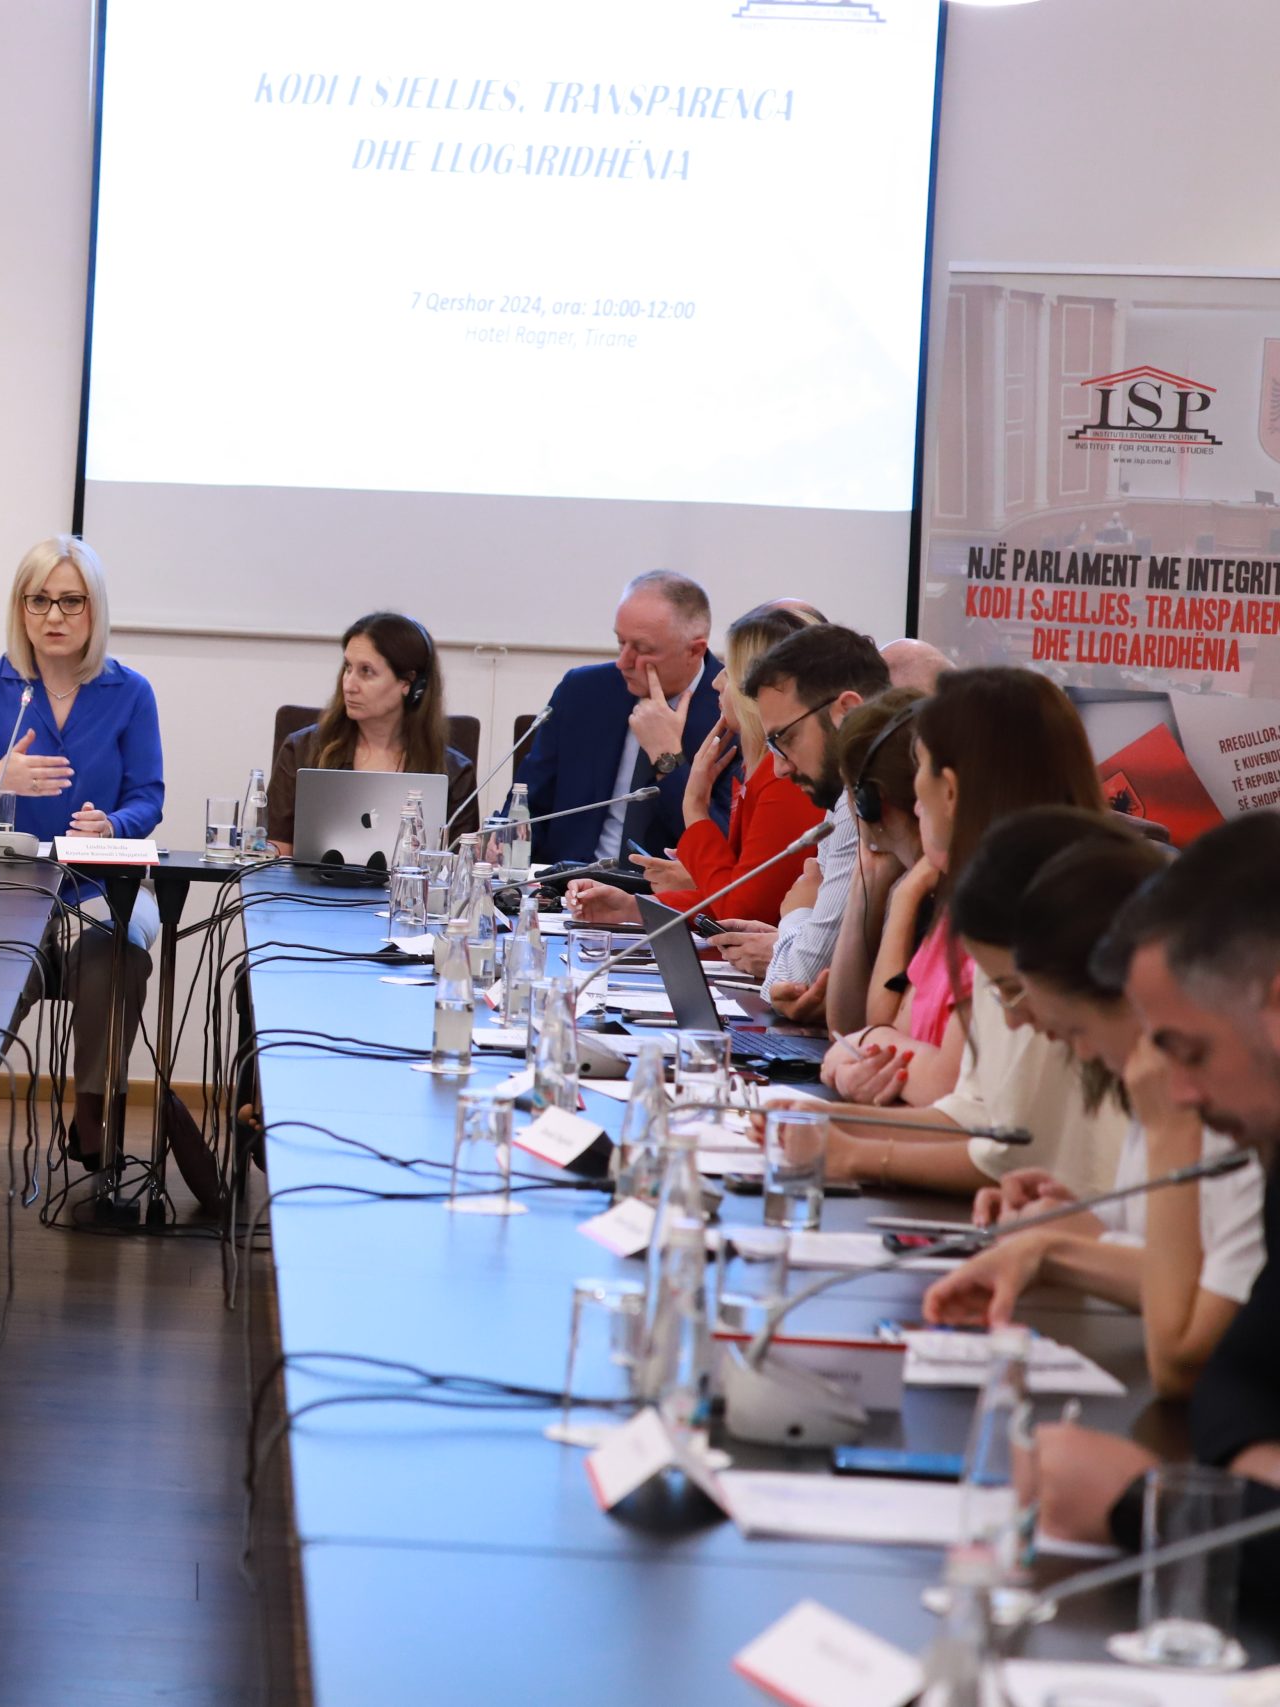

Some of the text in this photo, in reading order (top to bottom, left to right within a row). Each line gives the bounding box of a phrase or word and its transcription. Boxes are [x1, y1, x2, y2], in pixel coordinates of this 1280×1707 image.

[254, 72, 339, 106] KODI
[348, 75, 362, 106] I
[543, 81, 794, 121] TRANSPARENCA
[352, 139, 690, 181] DHE LLOGARIDHËNIA
[411, 291, 696, 320] 7 Qershor 2024, ora: 10:00-12:00
[466, 326, 510, 344] Hotel
[516, 325, 578, 350] Rogner,
[1095, 381, 1211, 430] ISP
[1075, 442, 1214, 455] INSTITUTE FOR POLITICAL STUDIES
[1168, 433, 1198, 441] POLITIKE
[1113, 457, 1171, 466] www.isp.com.al
[968, 542, 1280, 595] NJË PARLAMENT ME INTEGRIT
[965, 585, 1012, 620] KODI
[1017, 588, 1025, 620] I
[1030, 588, 1137, 629] SJELLJES,
[1032, 627, 1240, 672] DHE LLOGARIDHËNIA
[1234, 759, 1241, 772] E
[1232, 775, 1244, 793] TË
[1238, 795, 1250, 812] SË
